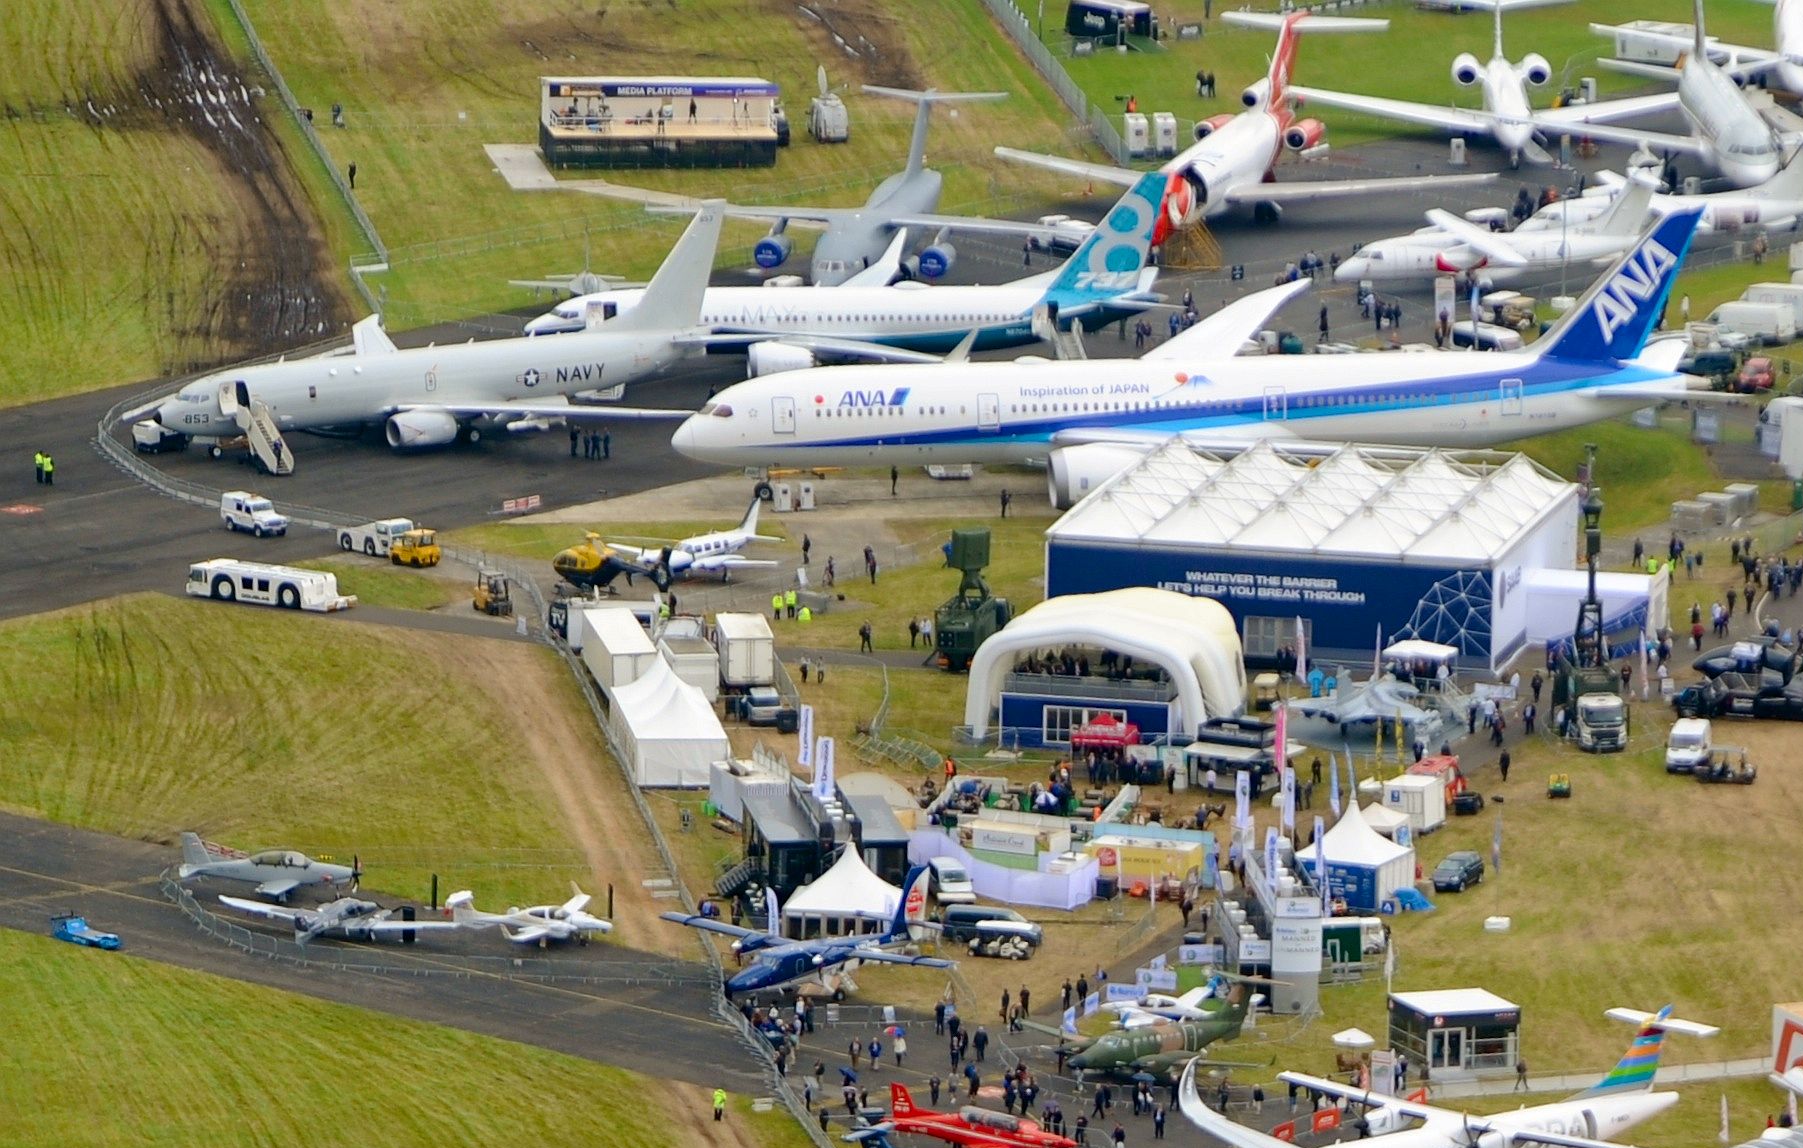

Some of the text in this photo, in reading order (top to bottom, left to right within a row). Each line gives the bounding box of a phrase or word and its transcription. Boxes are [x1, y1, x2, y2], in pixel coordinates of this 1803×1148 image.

[617, 86, 693, 96] MEDIA PLATFORM
[1592, 237, 1678, 345] ANA
[556, 363, 606, 383] NAVY
[838, 389, 886, 408] ANA
[1019, 383, 1150, 399] Inspiration of JAPAN
[185, 413, 210, 424] 853
[1186, 571, 1338, 590] WHATEVER THE BARRIER
[1158, 581, 1365, 604] LET'S HELP YOU BREAK THROUGH
